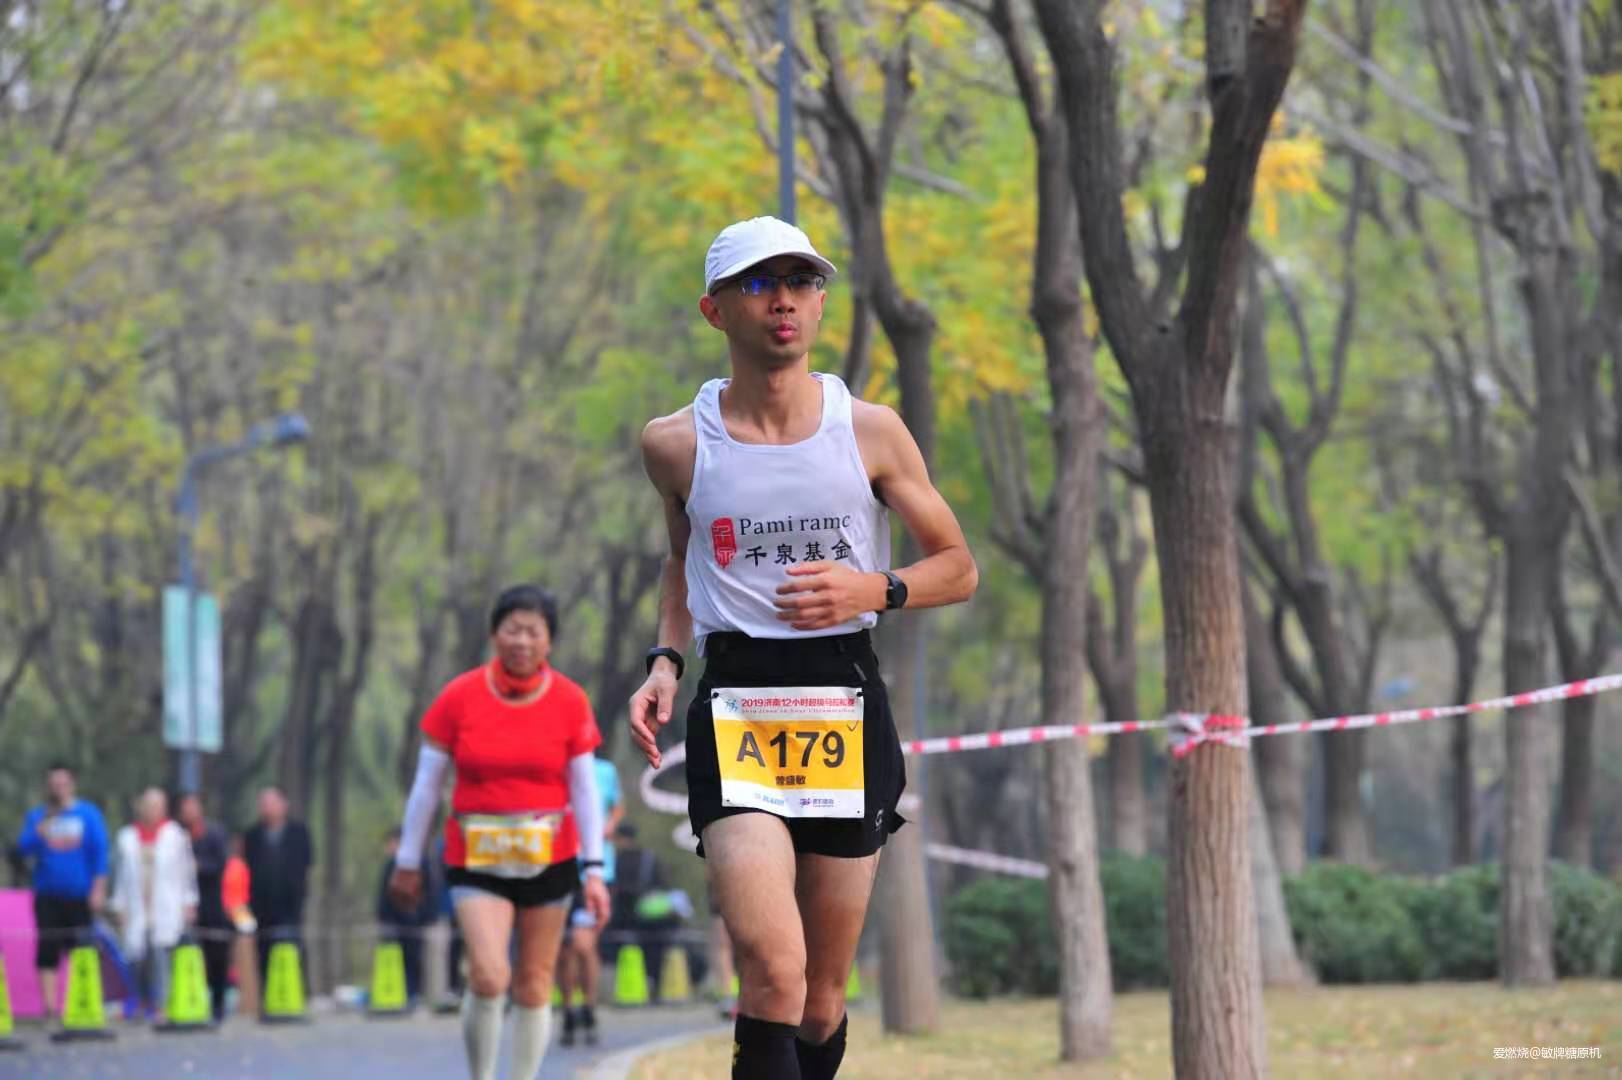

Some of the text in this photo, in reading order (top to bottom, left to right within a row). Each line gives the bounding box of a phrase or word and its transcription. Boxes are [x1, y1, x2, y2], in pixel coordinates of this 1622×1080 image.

[745, 540, 852, 566] 千泉基金
[736, 731, 845, 768] A179
